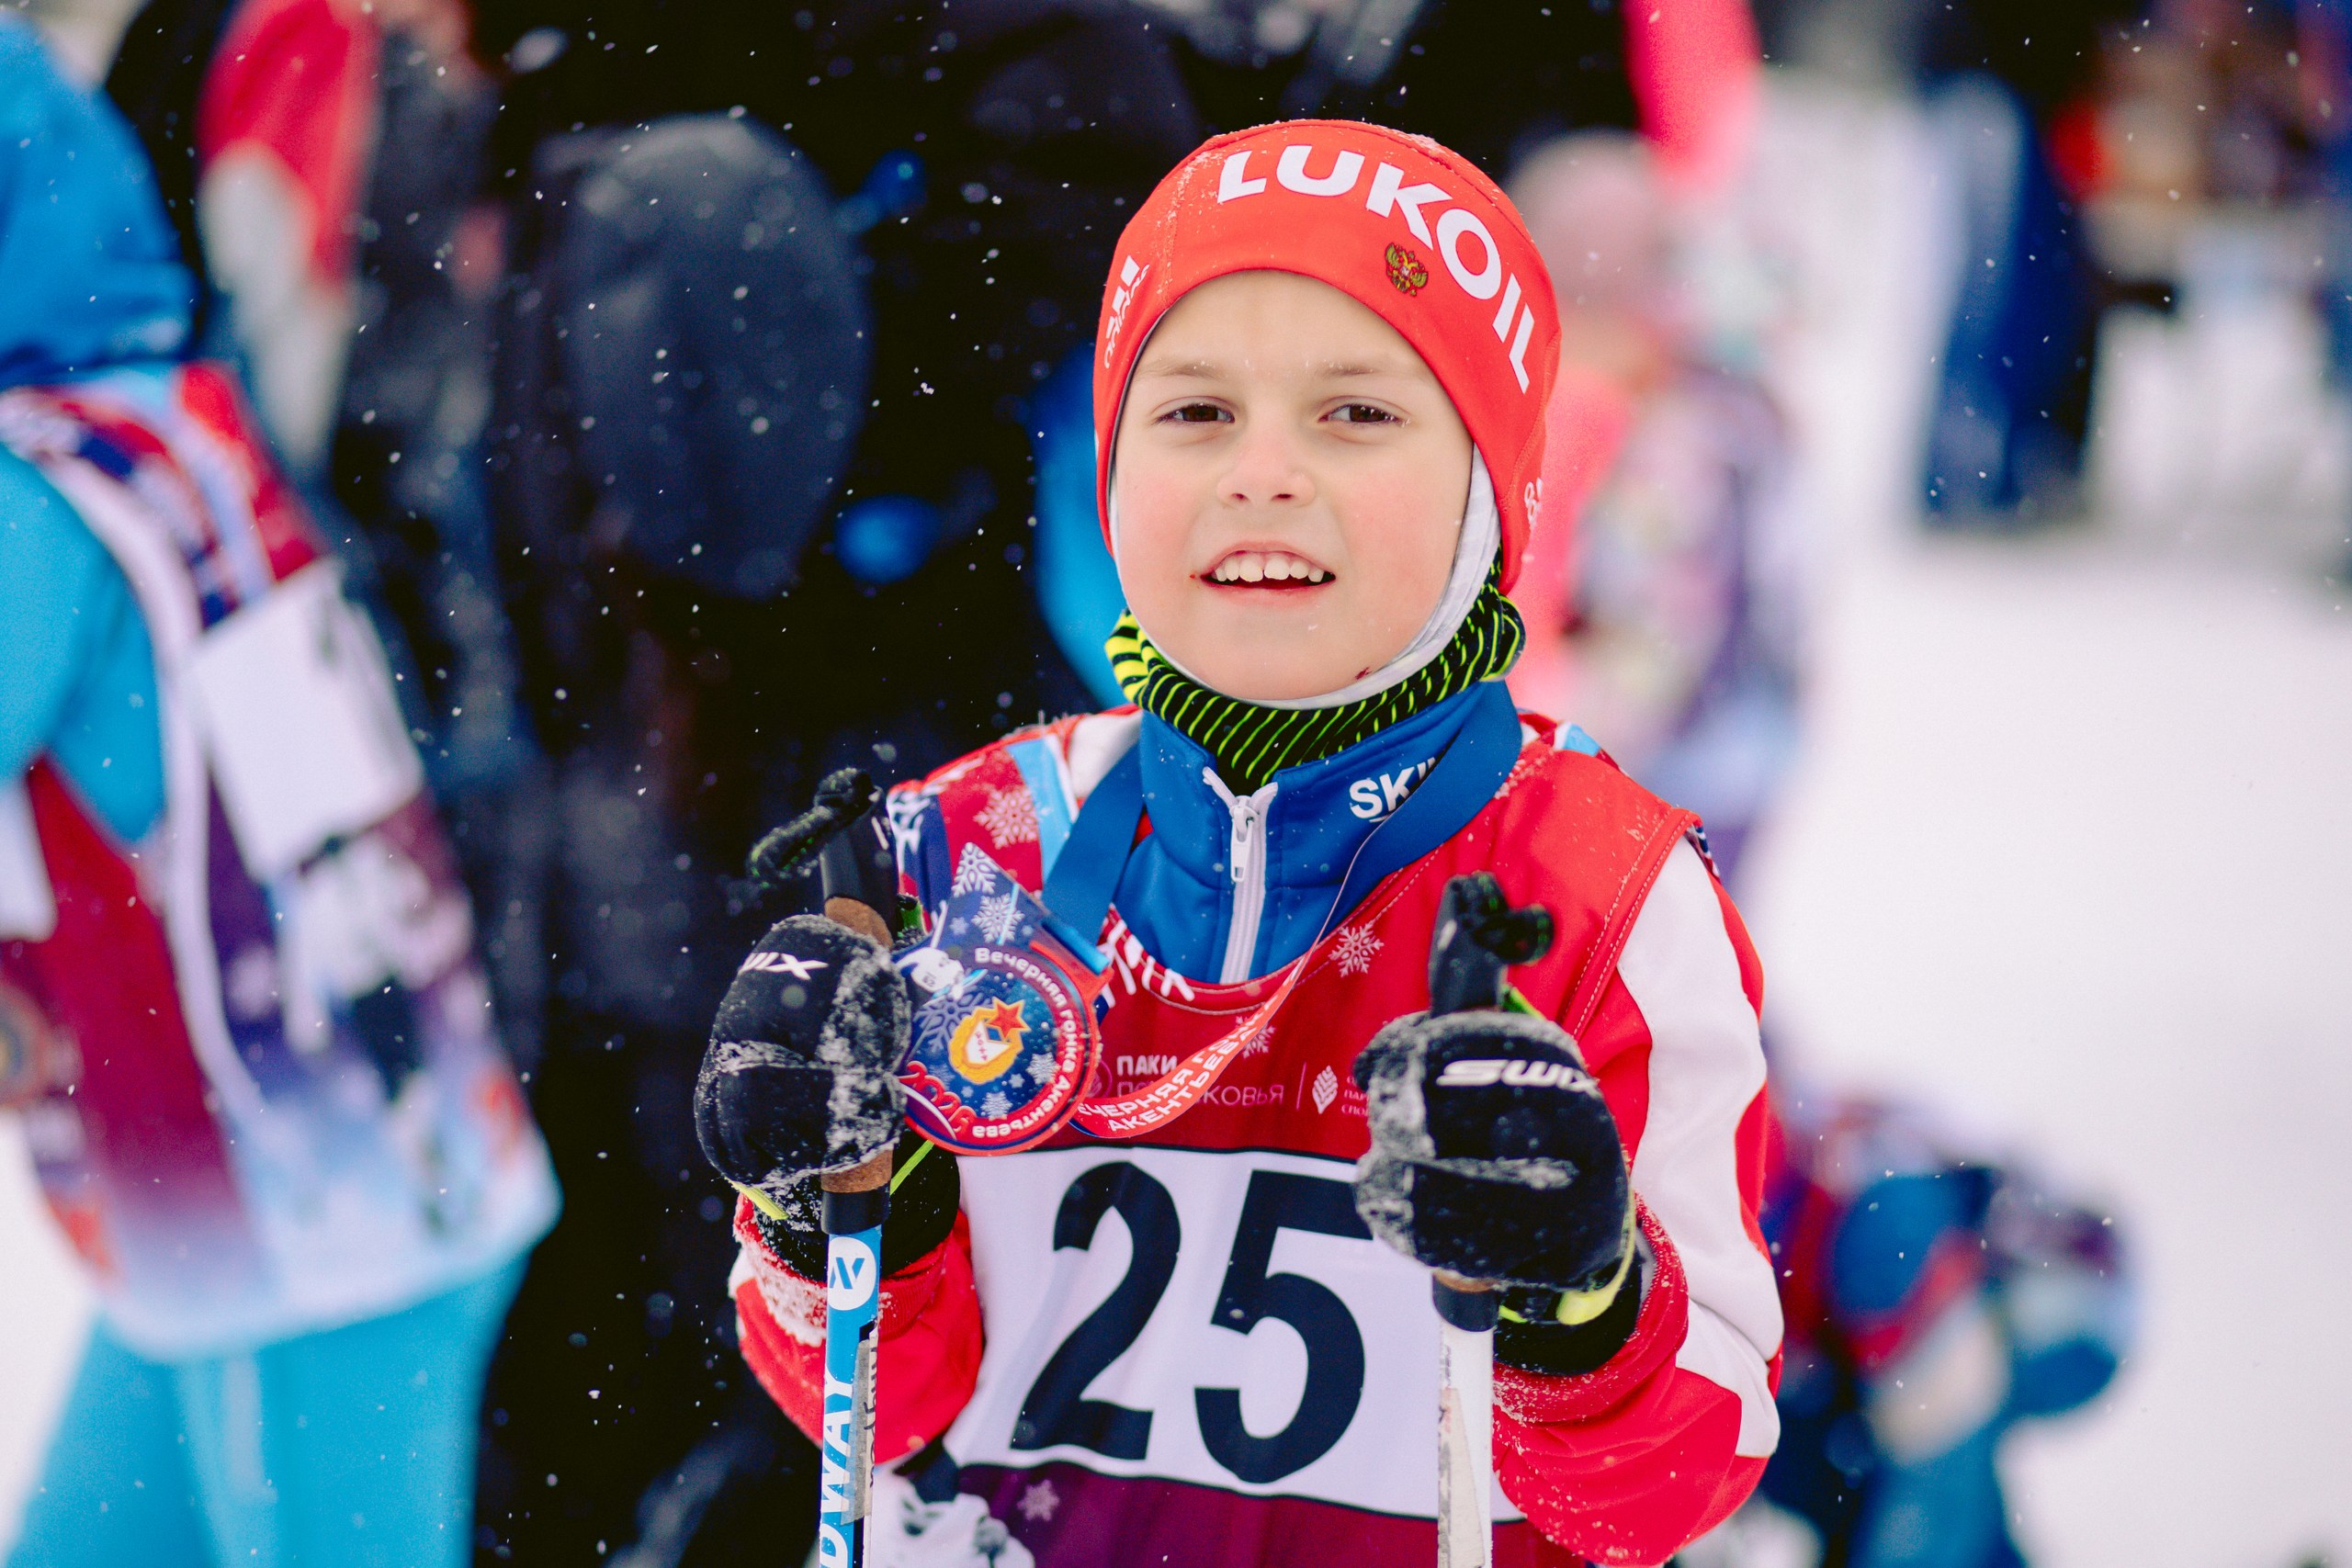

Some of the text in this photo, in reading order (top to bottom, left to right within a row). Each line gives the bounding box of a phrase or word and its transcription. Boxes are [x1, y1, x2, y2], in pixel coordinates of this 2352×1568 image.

[1216, 144, 1535, 394] LUKOIL
[974, 946, 1068, 1008] Вечерняя
[972, 1074, 1071, 1138] Акентьева
[1077, 1068, 1195, 1118] ЕЧЕРНЯЯ
[1009, 1159, 1374, 1484] 25
